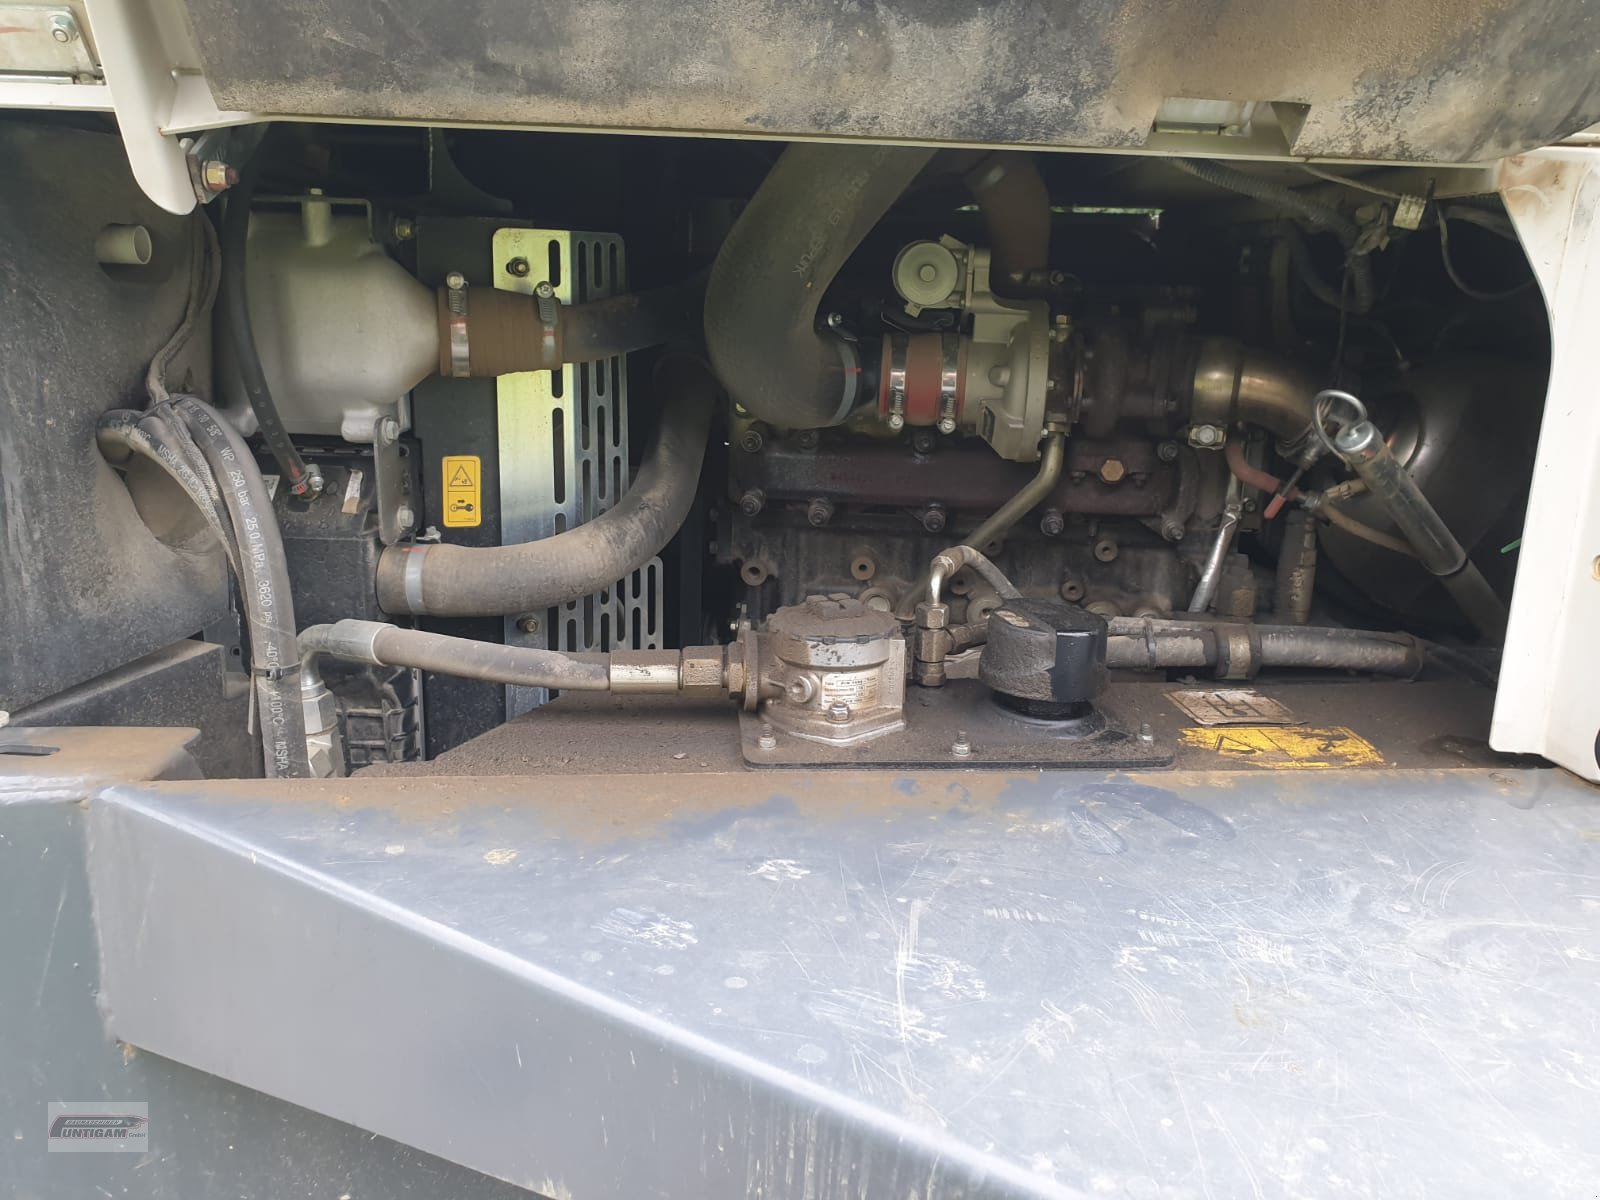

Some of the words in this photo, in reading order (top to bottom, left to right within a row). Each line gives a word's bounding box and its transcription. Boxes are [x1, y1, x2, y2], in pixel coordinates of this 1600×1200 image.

[220, 446, 235, 462] WP
[228, 469, 246, 488] 250
[237, 488, 250, 507] bar
[252, 543, 266, 569] MPa
[258, 580, 273, 607] 3620
[275, 740, 289, 770] MSHA
